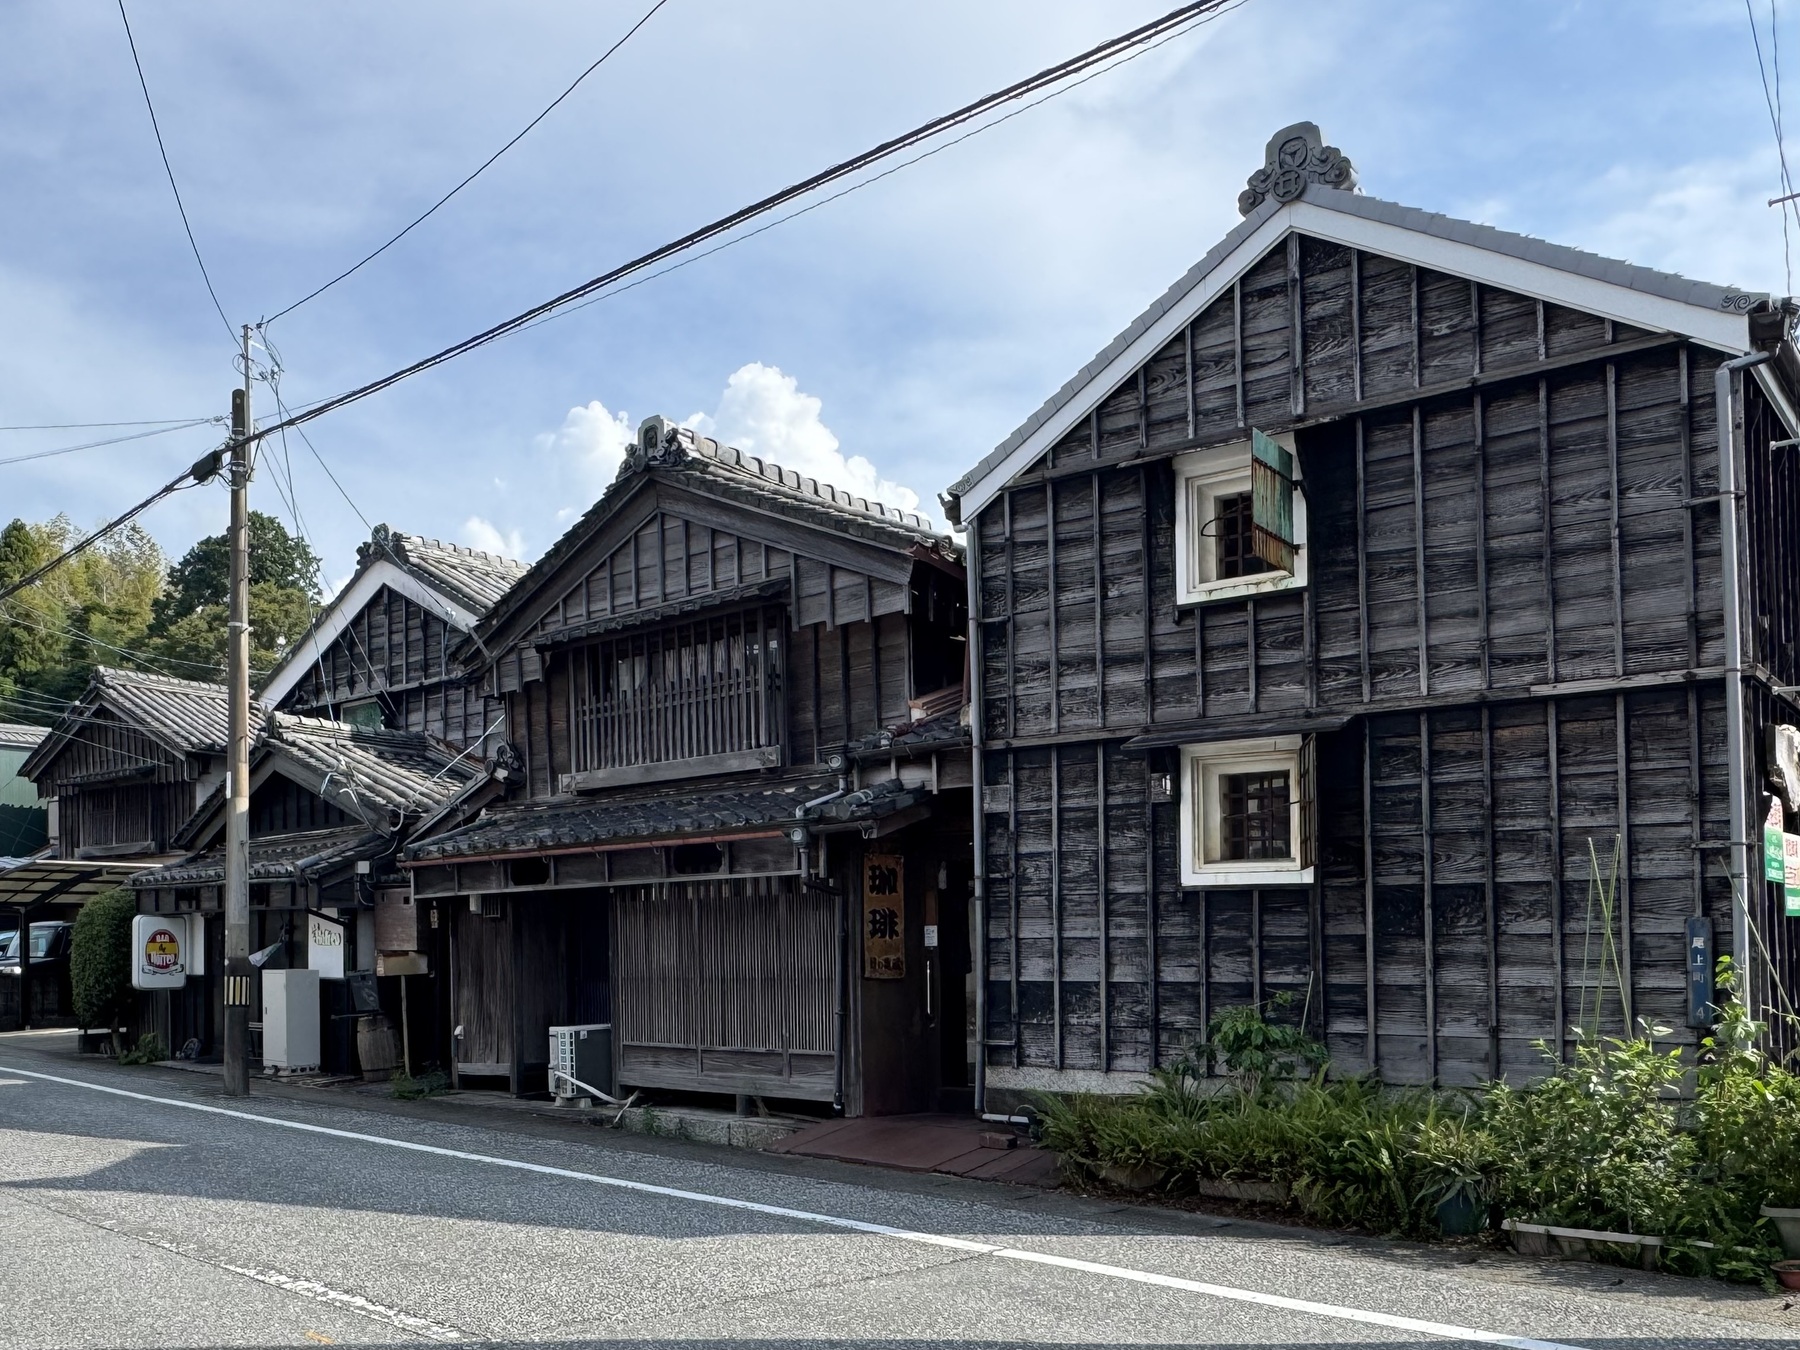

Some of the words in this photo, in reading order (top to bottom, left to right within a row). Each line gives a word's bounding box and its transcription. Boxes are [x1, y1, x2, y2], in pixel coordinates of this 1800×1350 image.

[868, 864, 899, 940] 珈琲
[1691, 936, 1706, 983] 尾上町
[1696, 1006, 1705, 1020] 4
